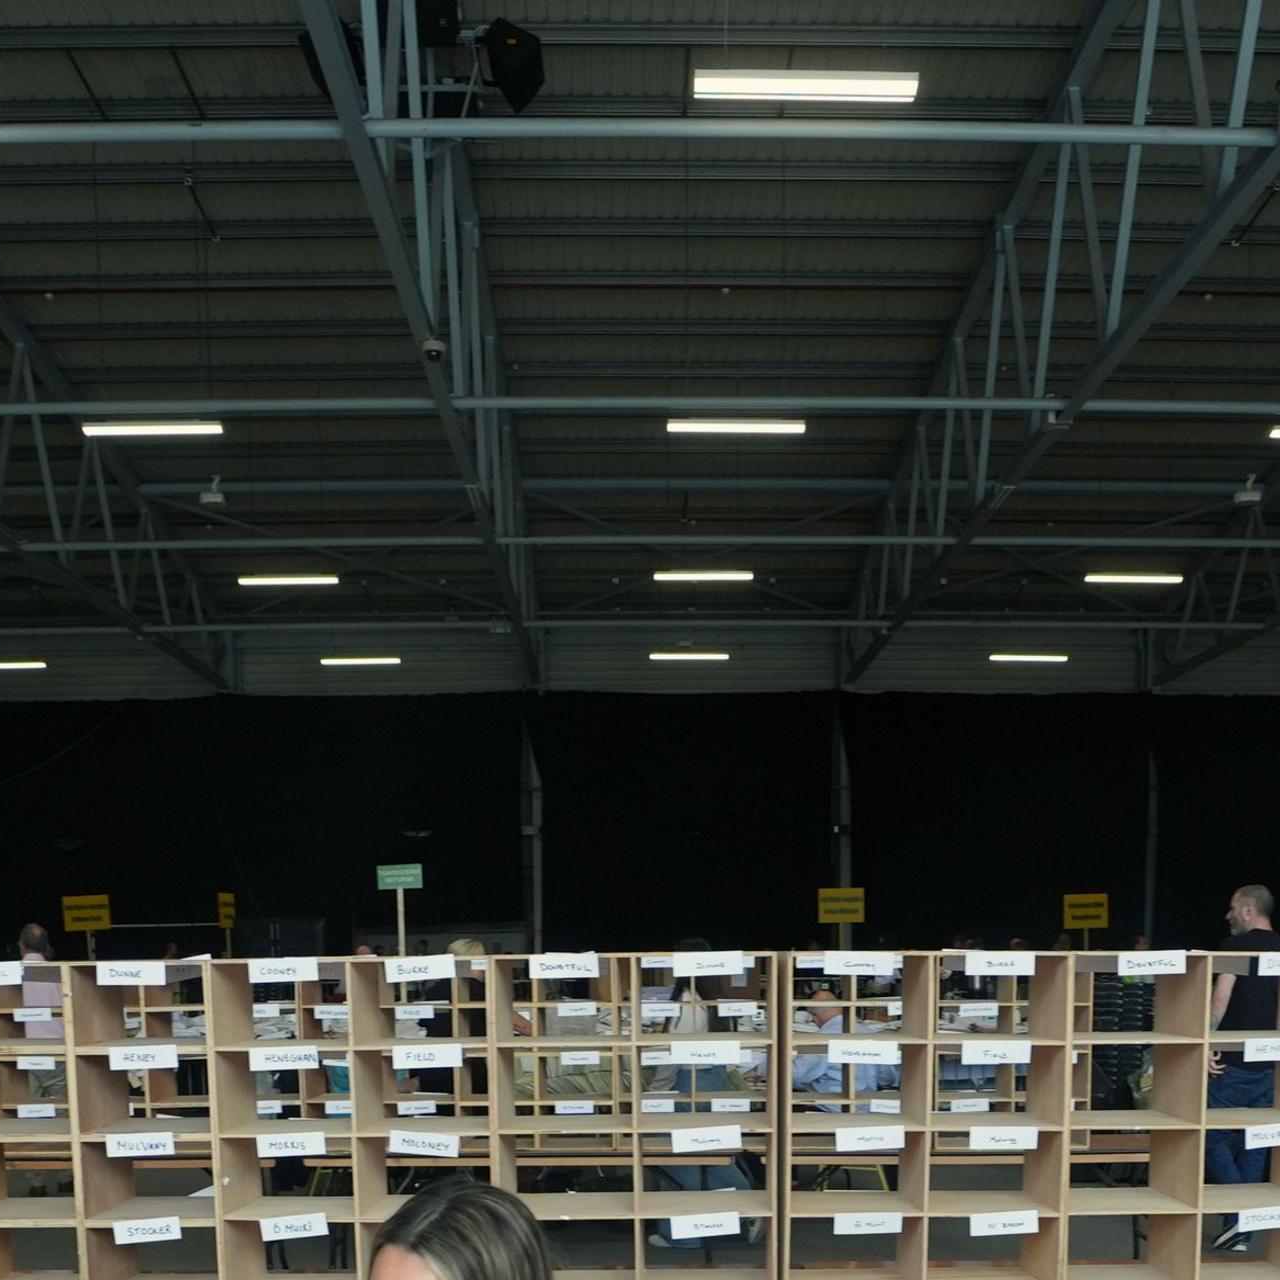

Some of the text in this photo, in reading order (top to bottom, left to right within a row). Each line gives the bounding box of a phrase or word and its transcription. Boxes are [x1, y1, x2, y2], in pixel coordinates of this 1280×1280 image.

[397, 965, 430, 975] BURKE
[122, 1053, 156, 1064] HENEY
[405, 1052, 436, 1062] FIELD
[401, 1137, 451, 1151] MOLONEY
[127, 1224, 173, 1237] STOCKER
